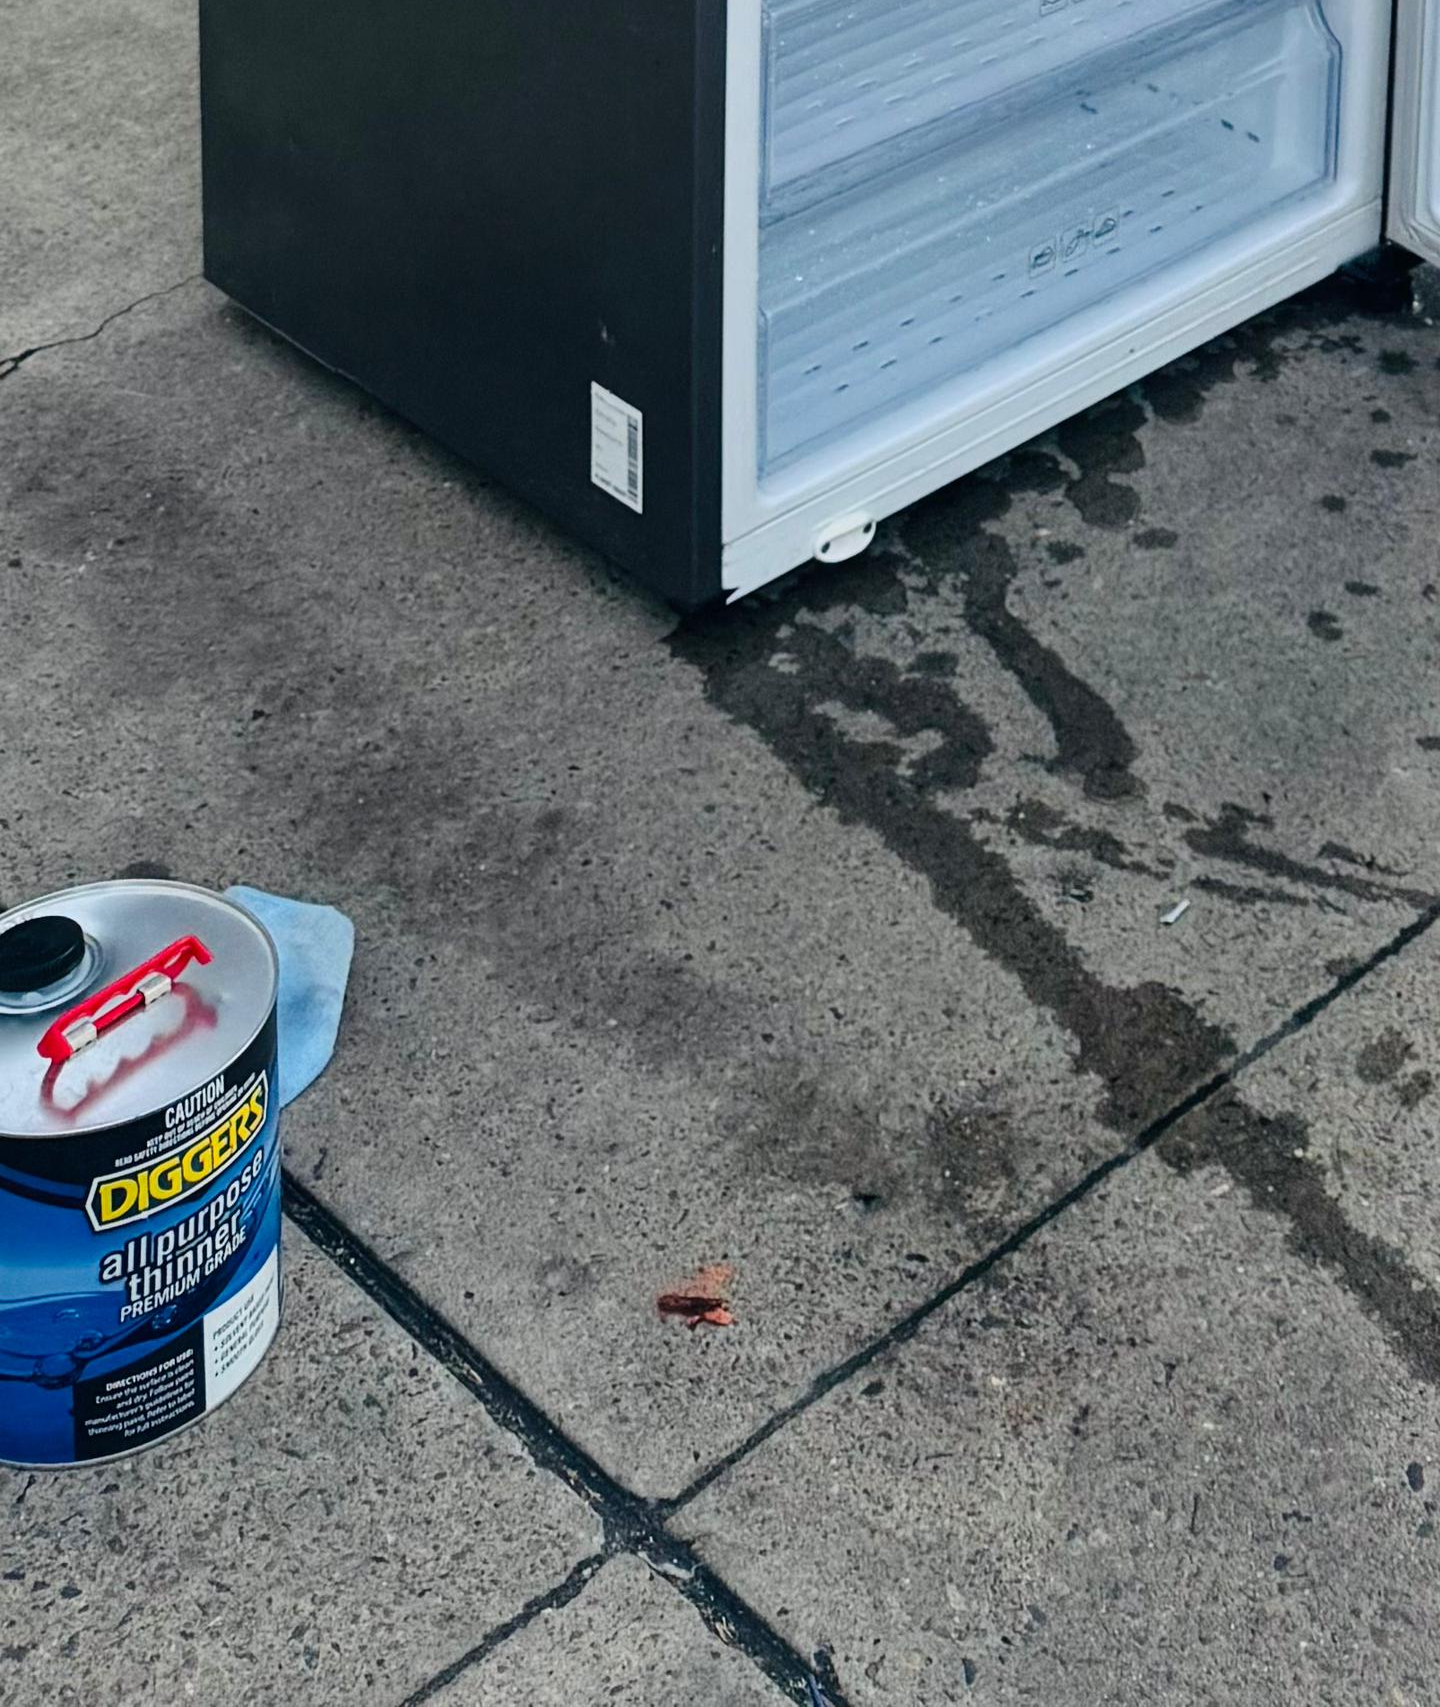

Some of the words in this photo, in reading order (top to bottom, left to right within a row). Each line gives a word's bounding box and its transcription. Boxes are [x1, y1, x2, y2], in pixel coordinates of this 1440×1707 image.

[165, 1074, 224, 1128] CAUTION
[100, 1085, 264, 1222] DIGGERS
[102, 1235, 148, 1281] all
[157, 1149, 264, 1266] purpose
[129, 1209, 241, 1303] thinner
[120, 1269, 200, 1324] PREMIUM
[205, 1225, 247, 1276] GRADE
[106, 1367, 157, 1391] DIRECTIONS
[159, 1358, 176, 1373] FOR
